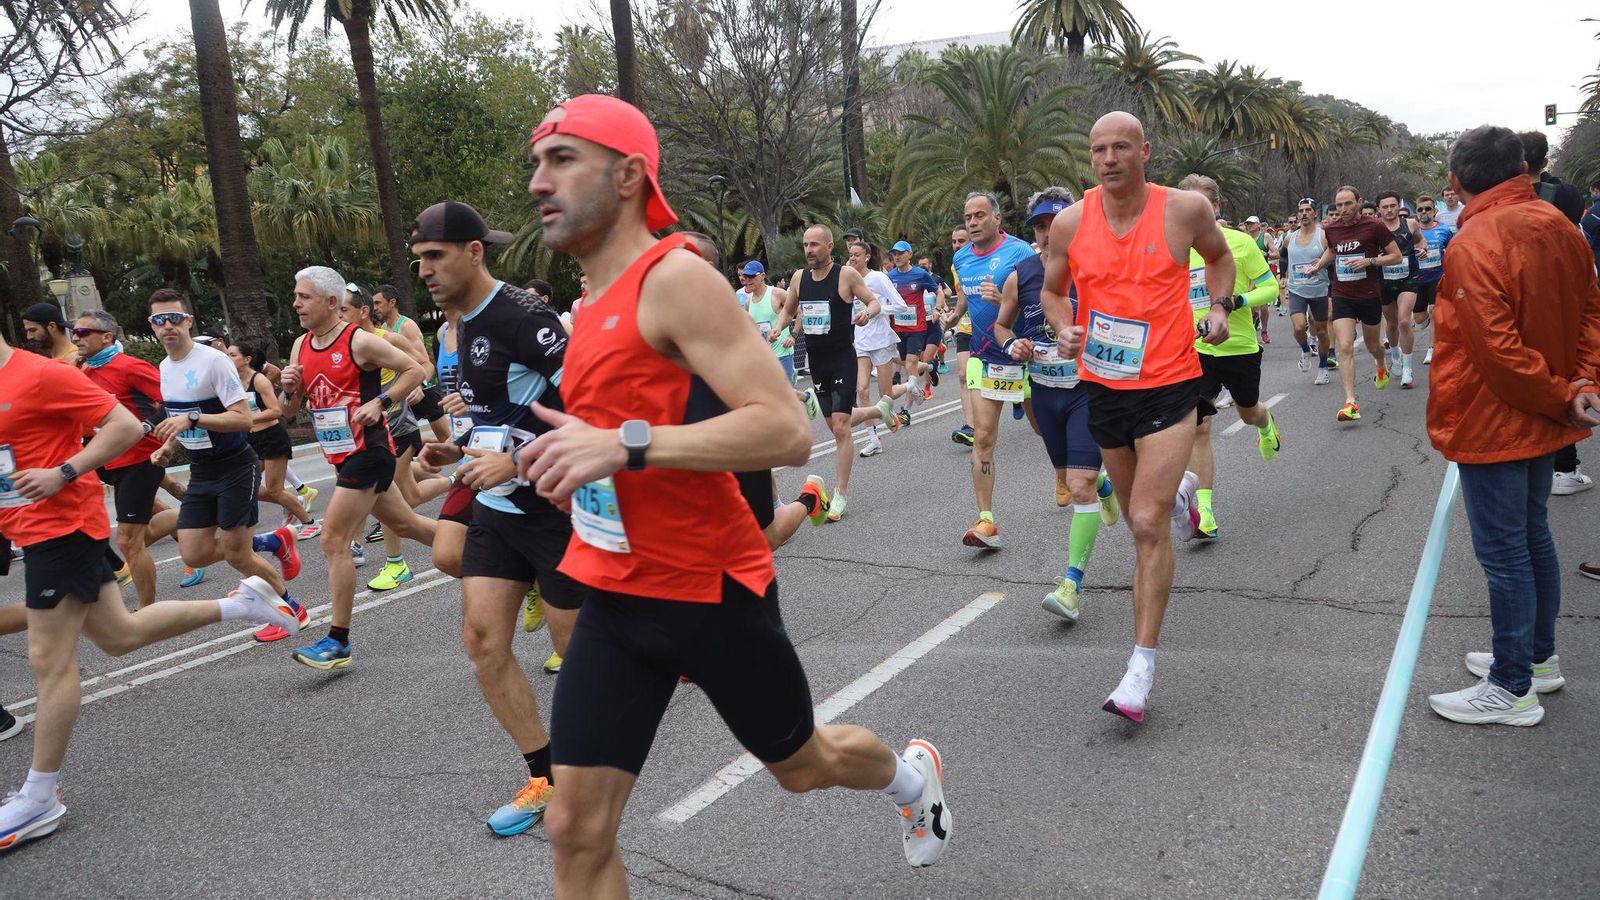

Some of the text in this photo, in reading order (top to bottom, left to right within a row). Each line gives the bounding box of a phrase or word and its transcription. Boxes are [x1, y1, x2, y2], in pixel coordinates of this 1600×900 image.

[1335, 241, 1360, 252] WILD
[807, 317, 823, 326] 670
[1095, 344, 1125, 365] 214
[1041, 365, 1065, 377] 561
[993, 380, 1015, 391] 927
[322, 430, 341, 442] 423
